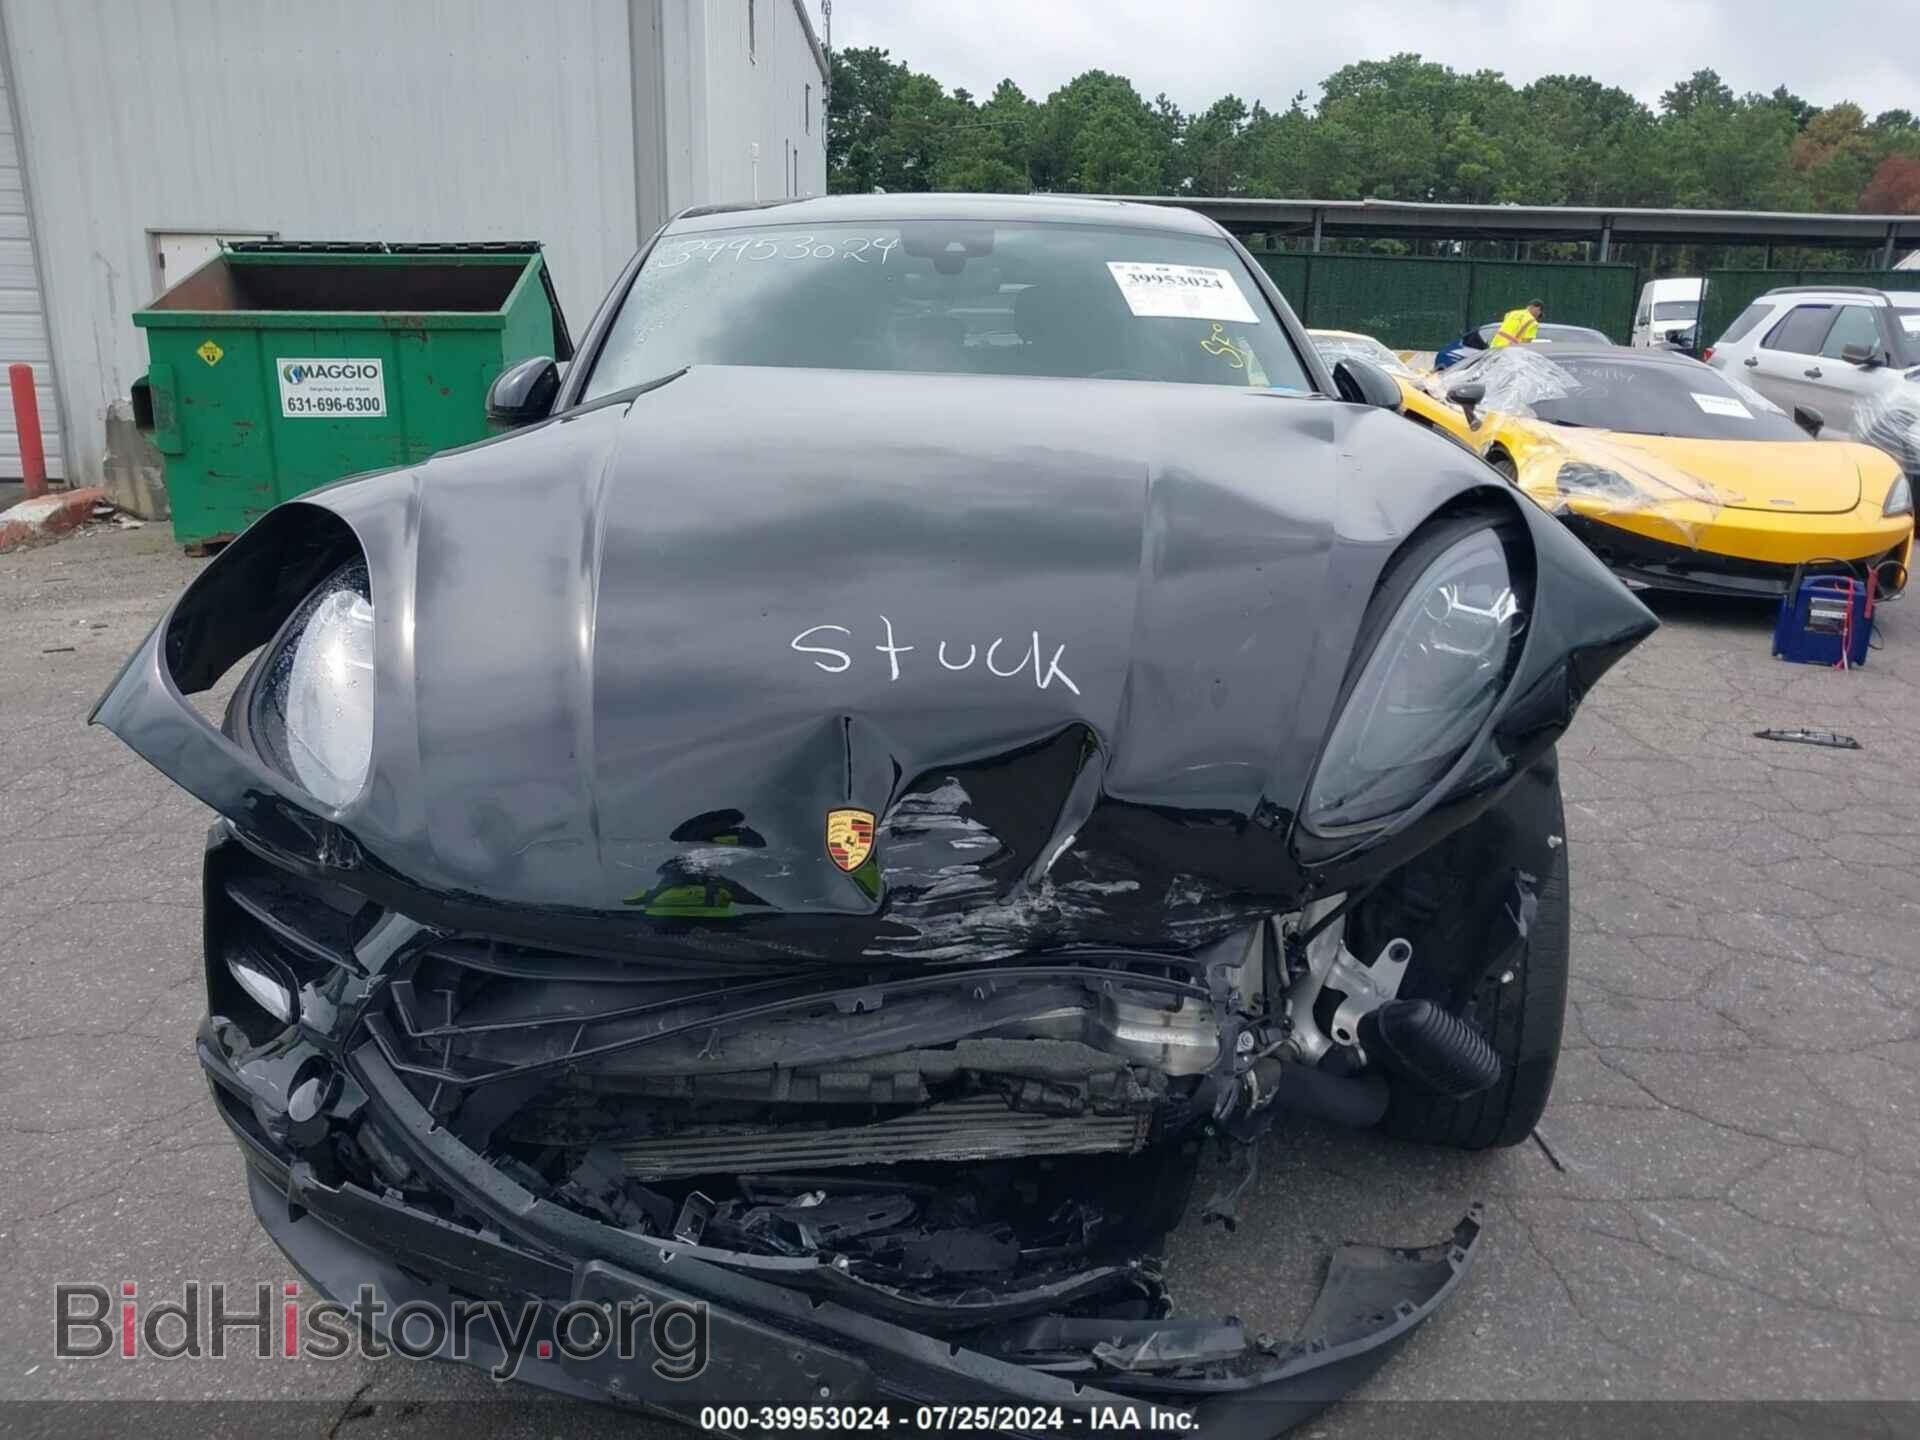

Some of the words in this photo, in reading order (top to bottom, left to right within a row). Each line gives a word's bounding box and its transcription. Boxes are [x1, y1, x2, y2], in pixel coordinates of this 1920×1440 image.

[1127, 272, 1225, 290] 39953024
[300, 365, 378, 379] MAGGIO
[287, 397, 380, 411] 631-696-6300
